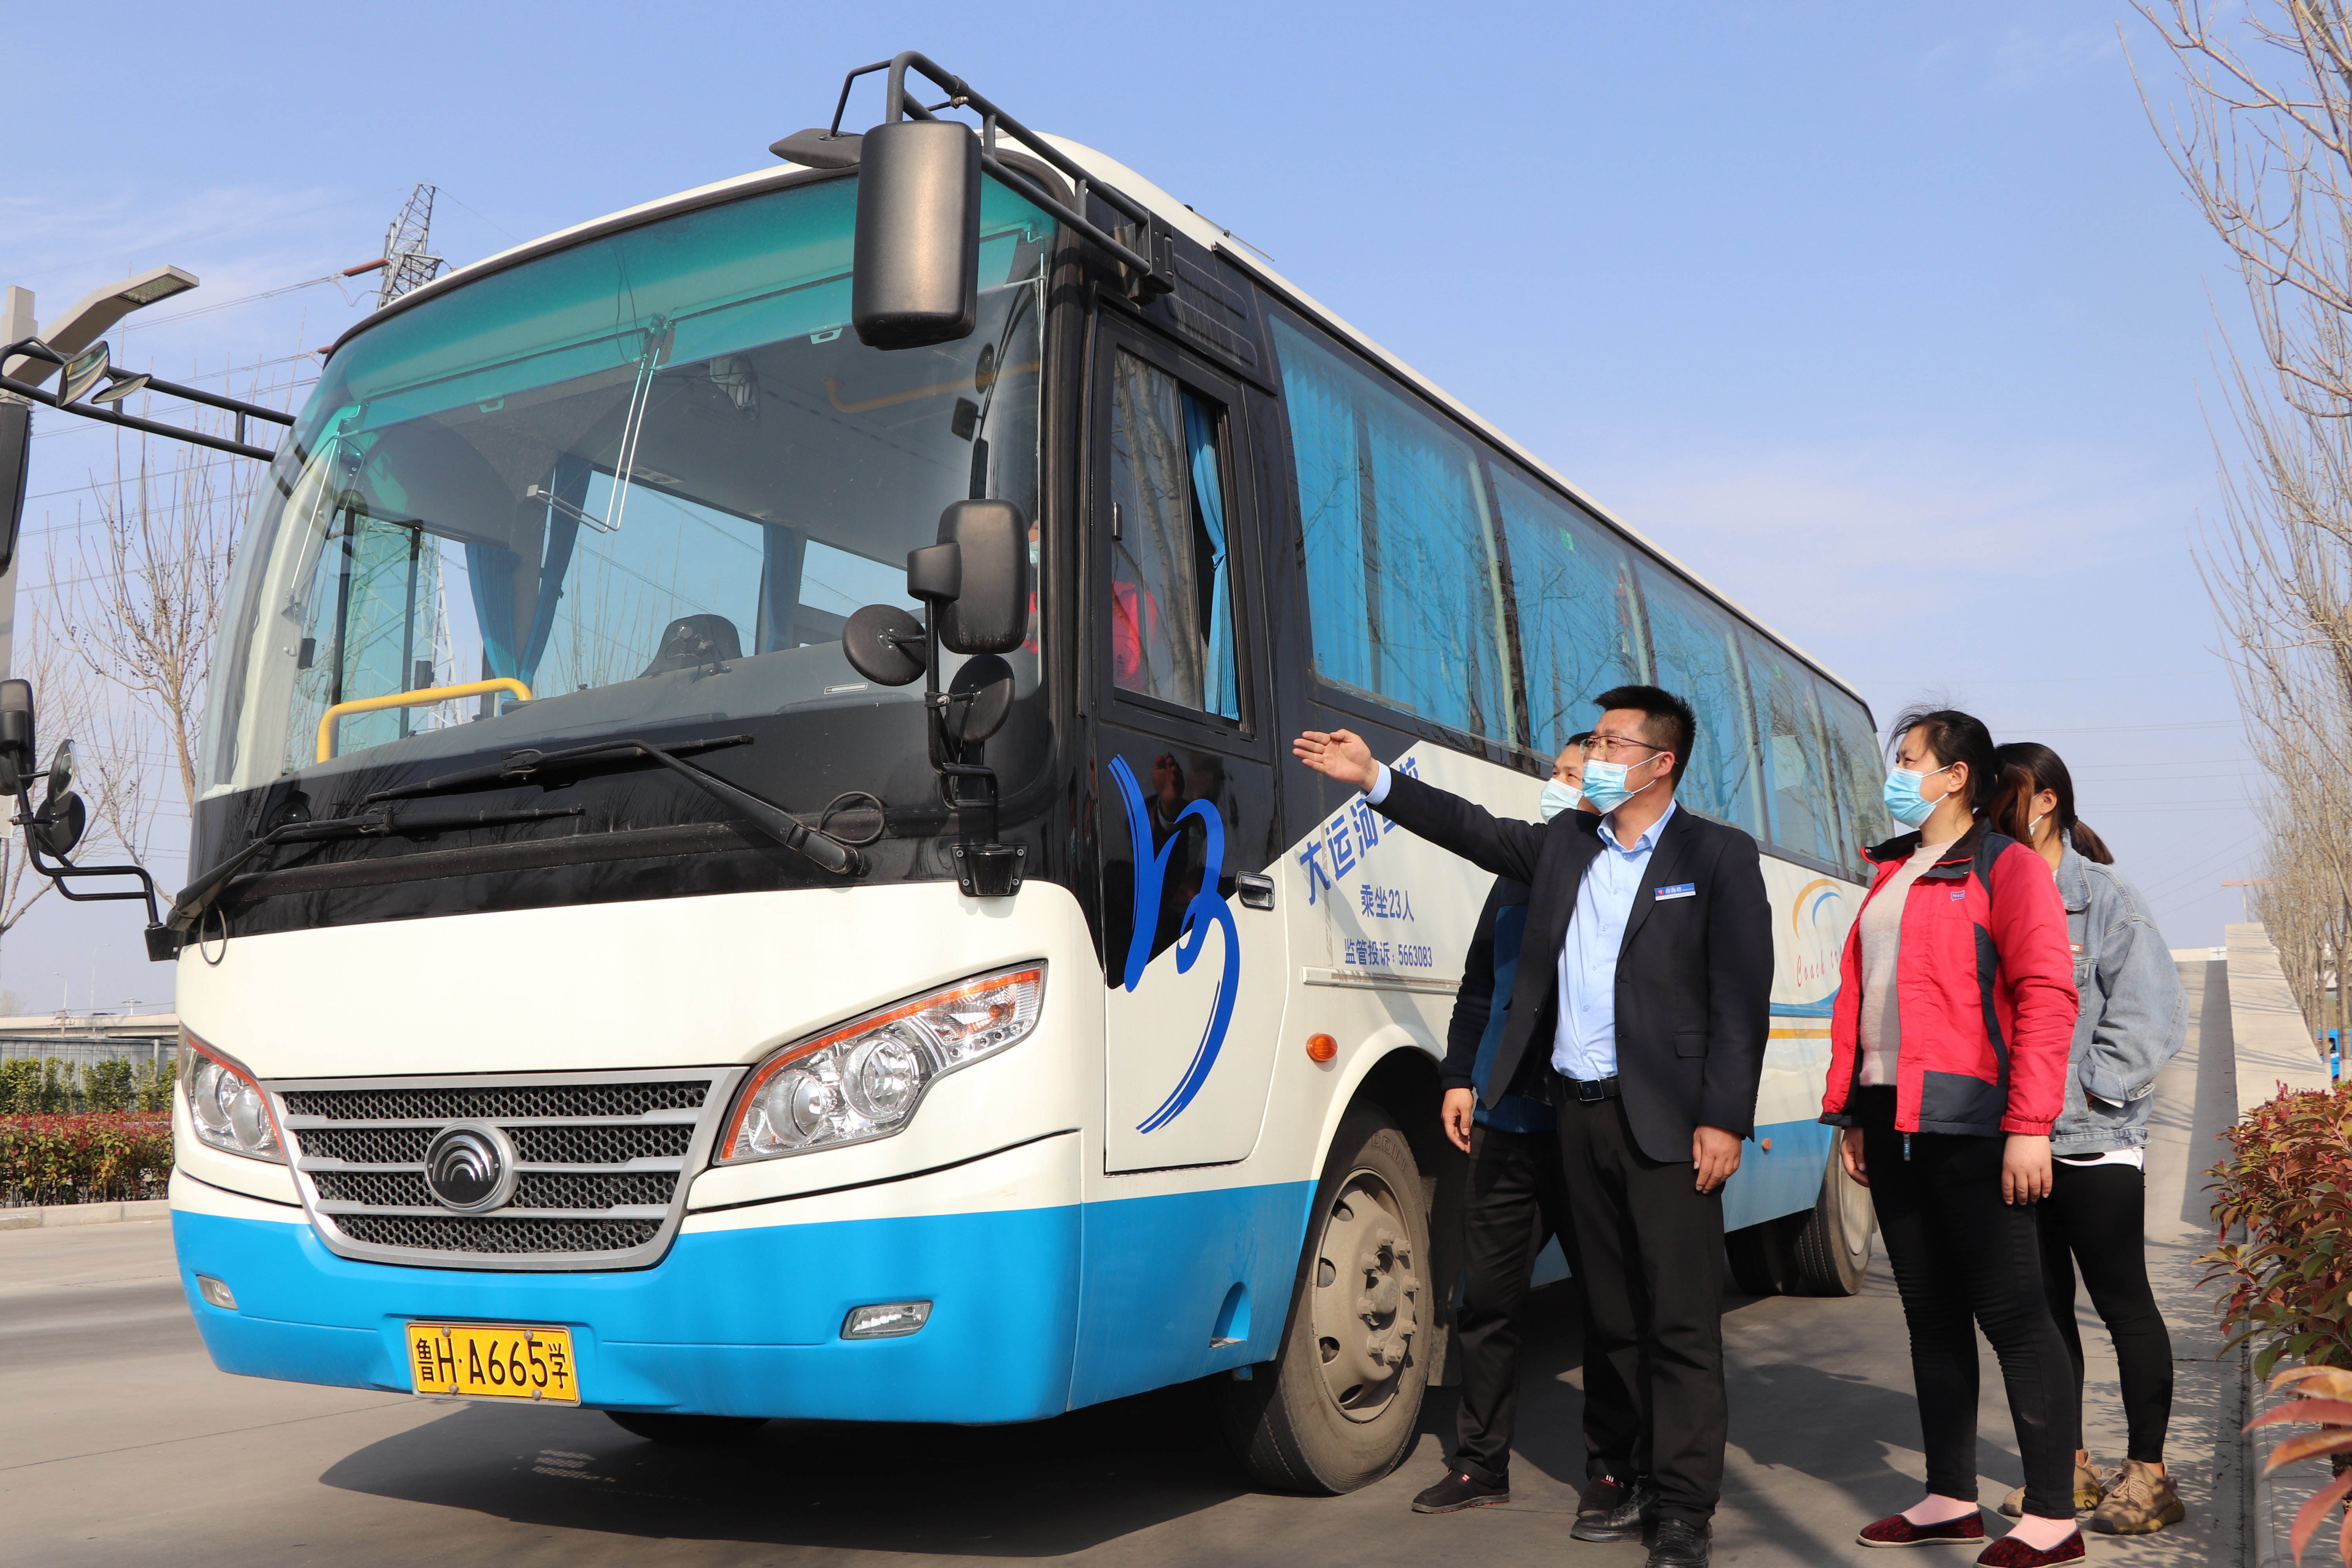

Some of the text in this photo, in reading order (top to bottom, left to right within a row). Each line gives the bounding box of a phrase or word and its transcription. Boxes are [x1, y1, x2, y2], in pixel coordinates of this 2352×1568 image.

[1299, 756, 1419, 906] 大运河
[1360, 884, 1415, 922] 乘坐23人
[1797, 950, 1825, 988] Coach
